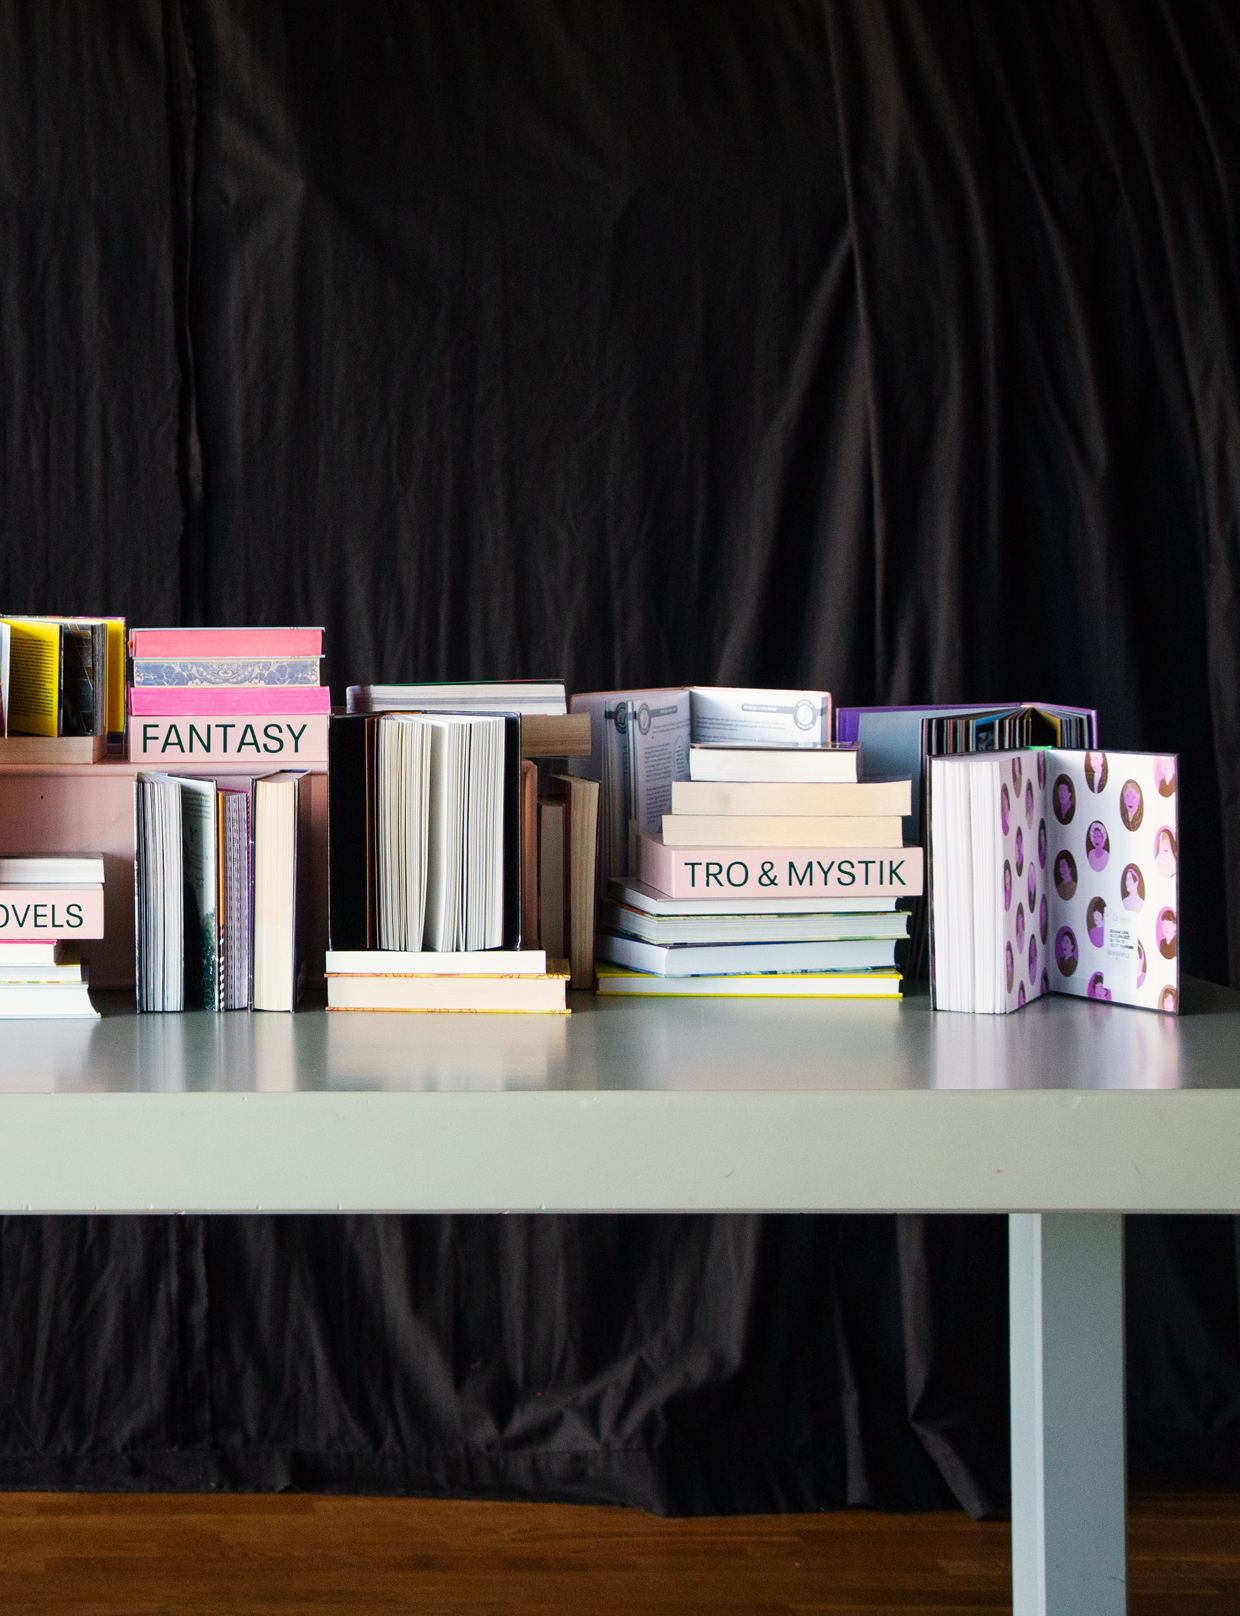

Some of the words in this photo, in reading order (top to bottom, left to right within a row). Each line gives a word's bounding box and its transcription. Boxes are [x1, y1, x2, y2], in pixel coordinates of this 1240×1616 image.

[142, 723, 308, 754] FANTASY
[684, 860, 749, 888] TRO
[758, 860, 780, 887] &
[788, 860, 908, 887] MYSTIK
